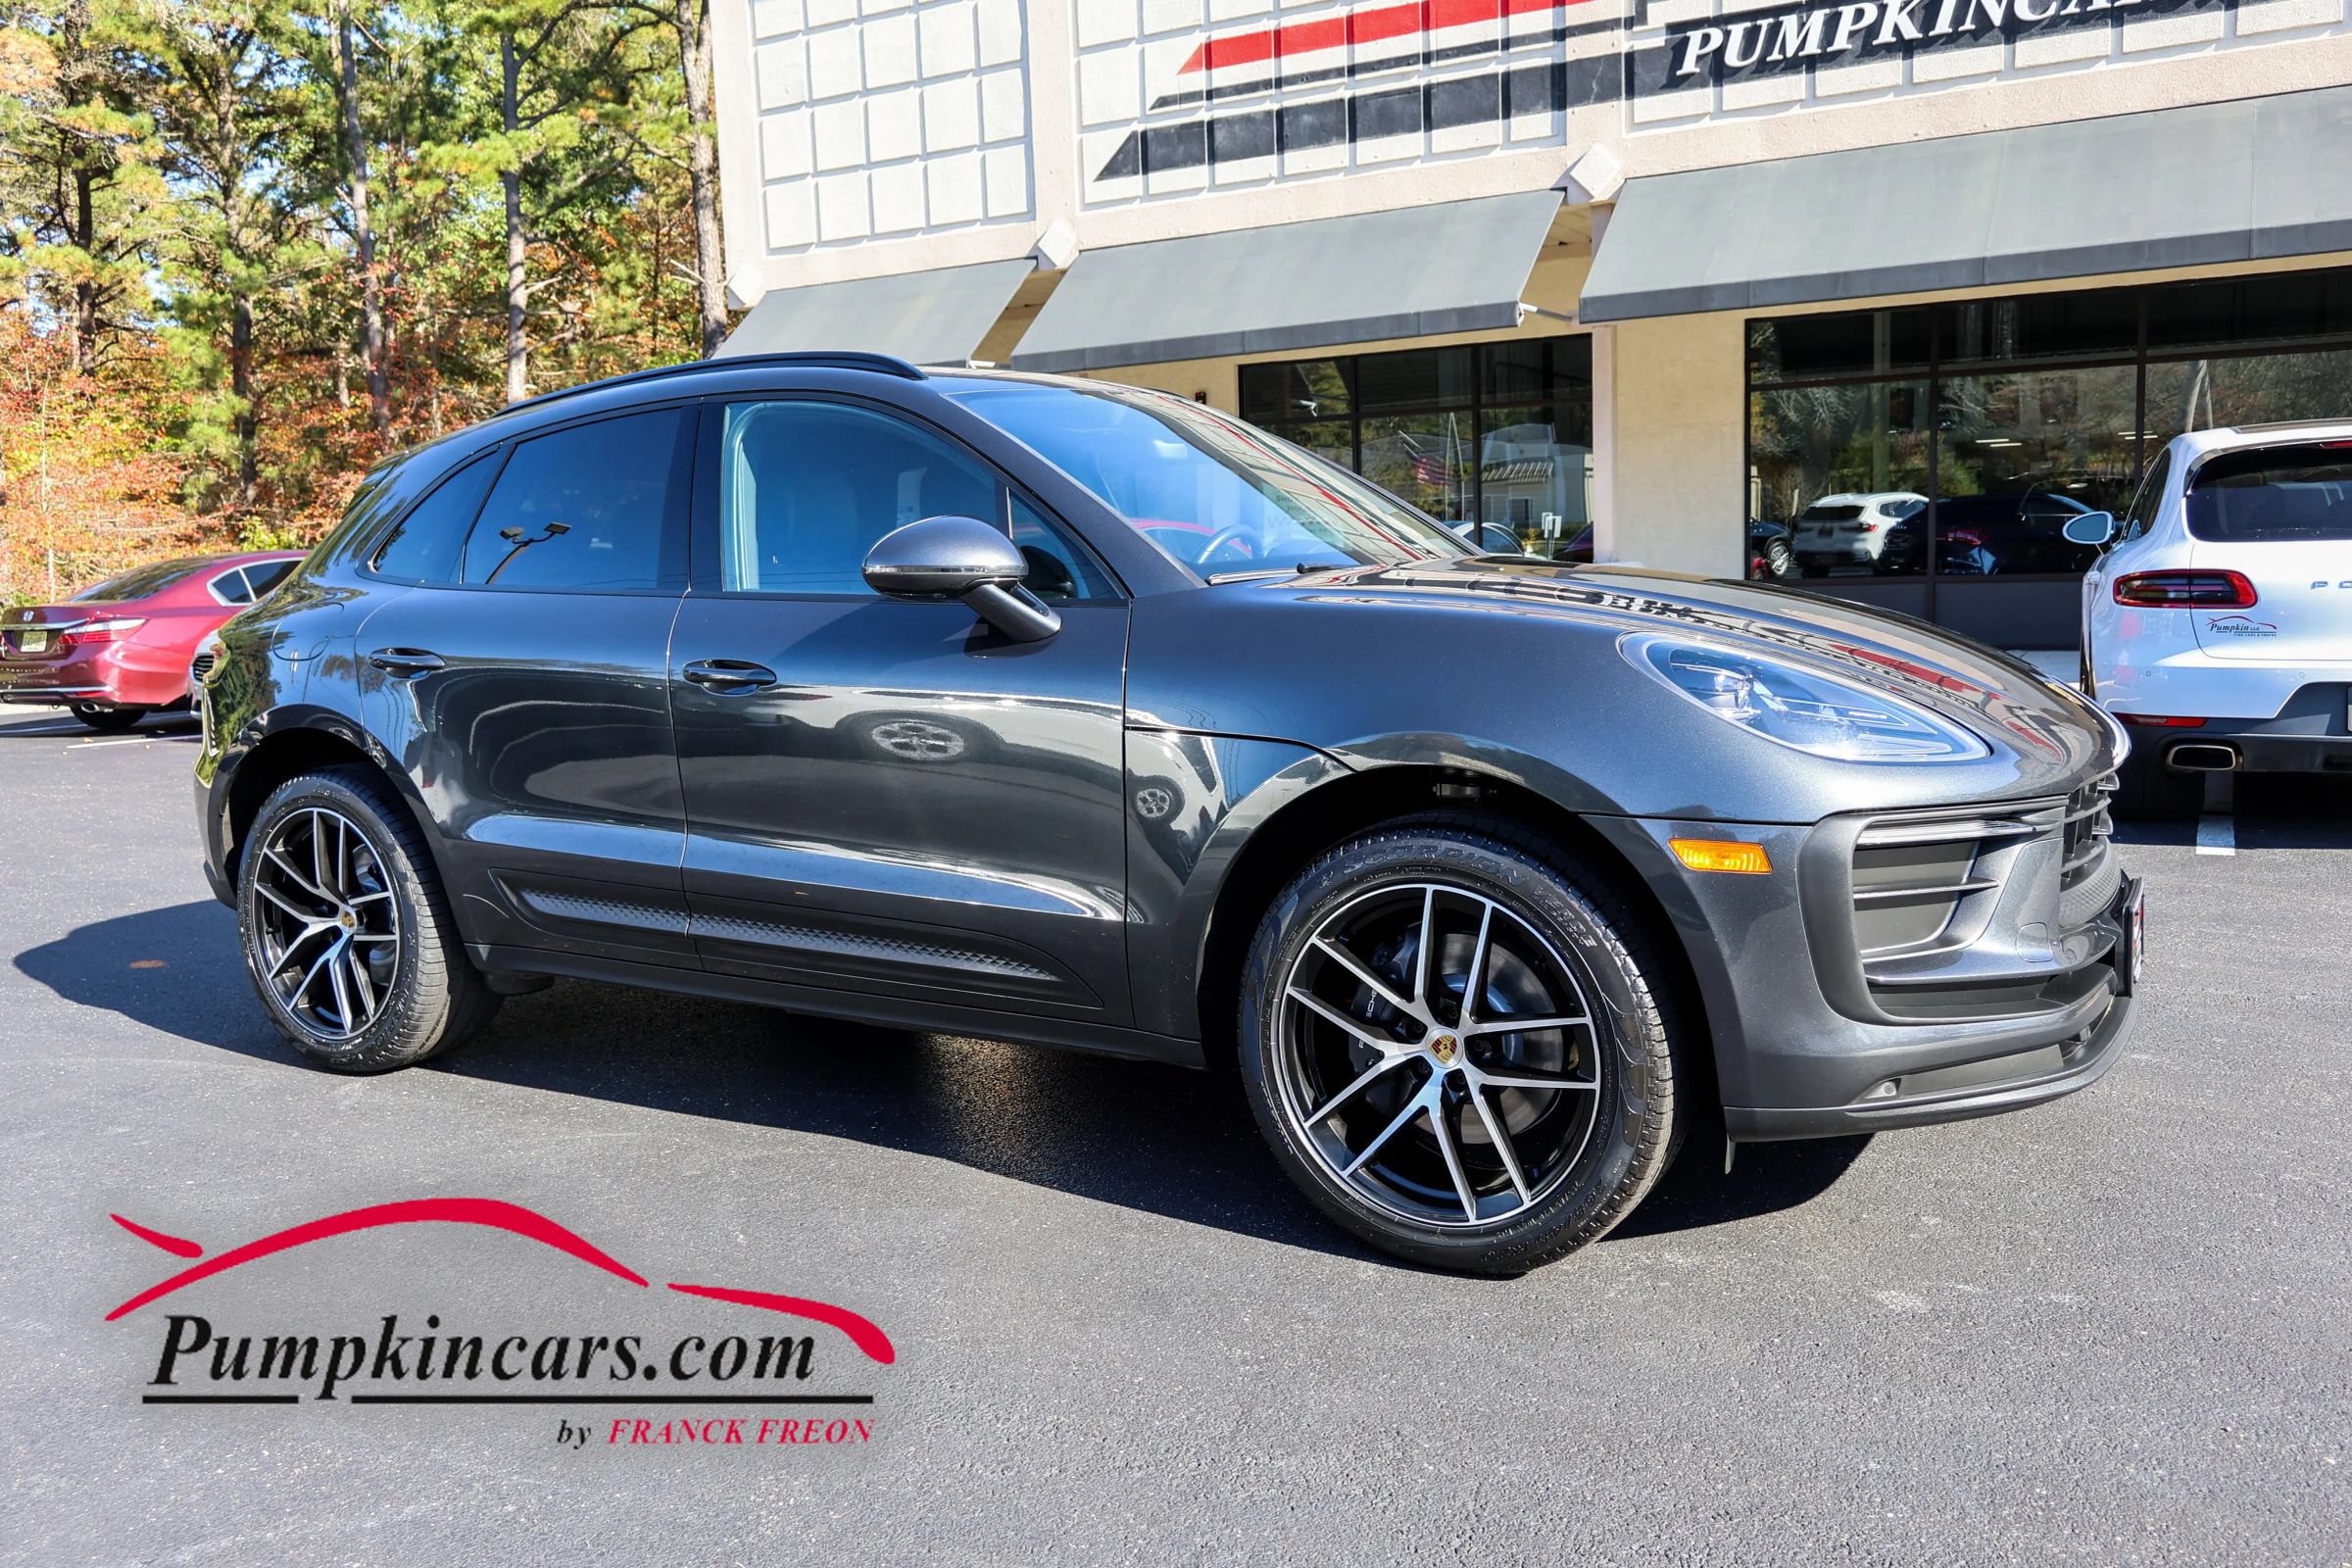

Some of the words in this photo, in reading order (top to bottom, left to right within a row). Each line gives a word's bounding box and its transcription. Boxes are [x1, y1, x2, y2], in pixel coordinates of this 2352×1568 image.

[1676, 0, 2141, 75] PUMPKIN
[2210, 623, 2249, 633] Pumpkin
[1343, 844, 1527, 887] SCORPION
